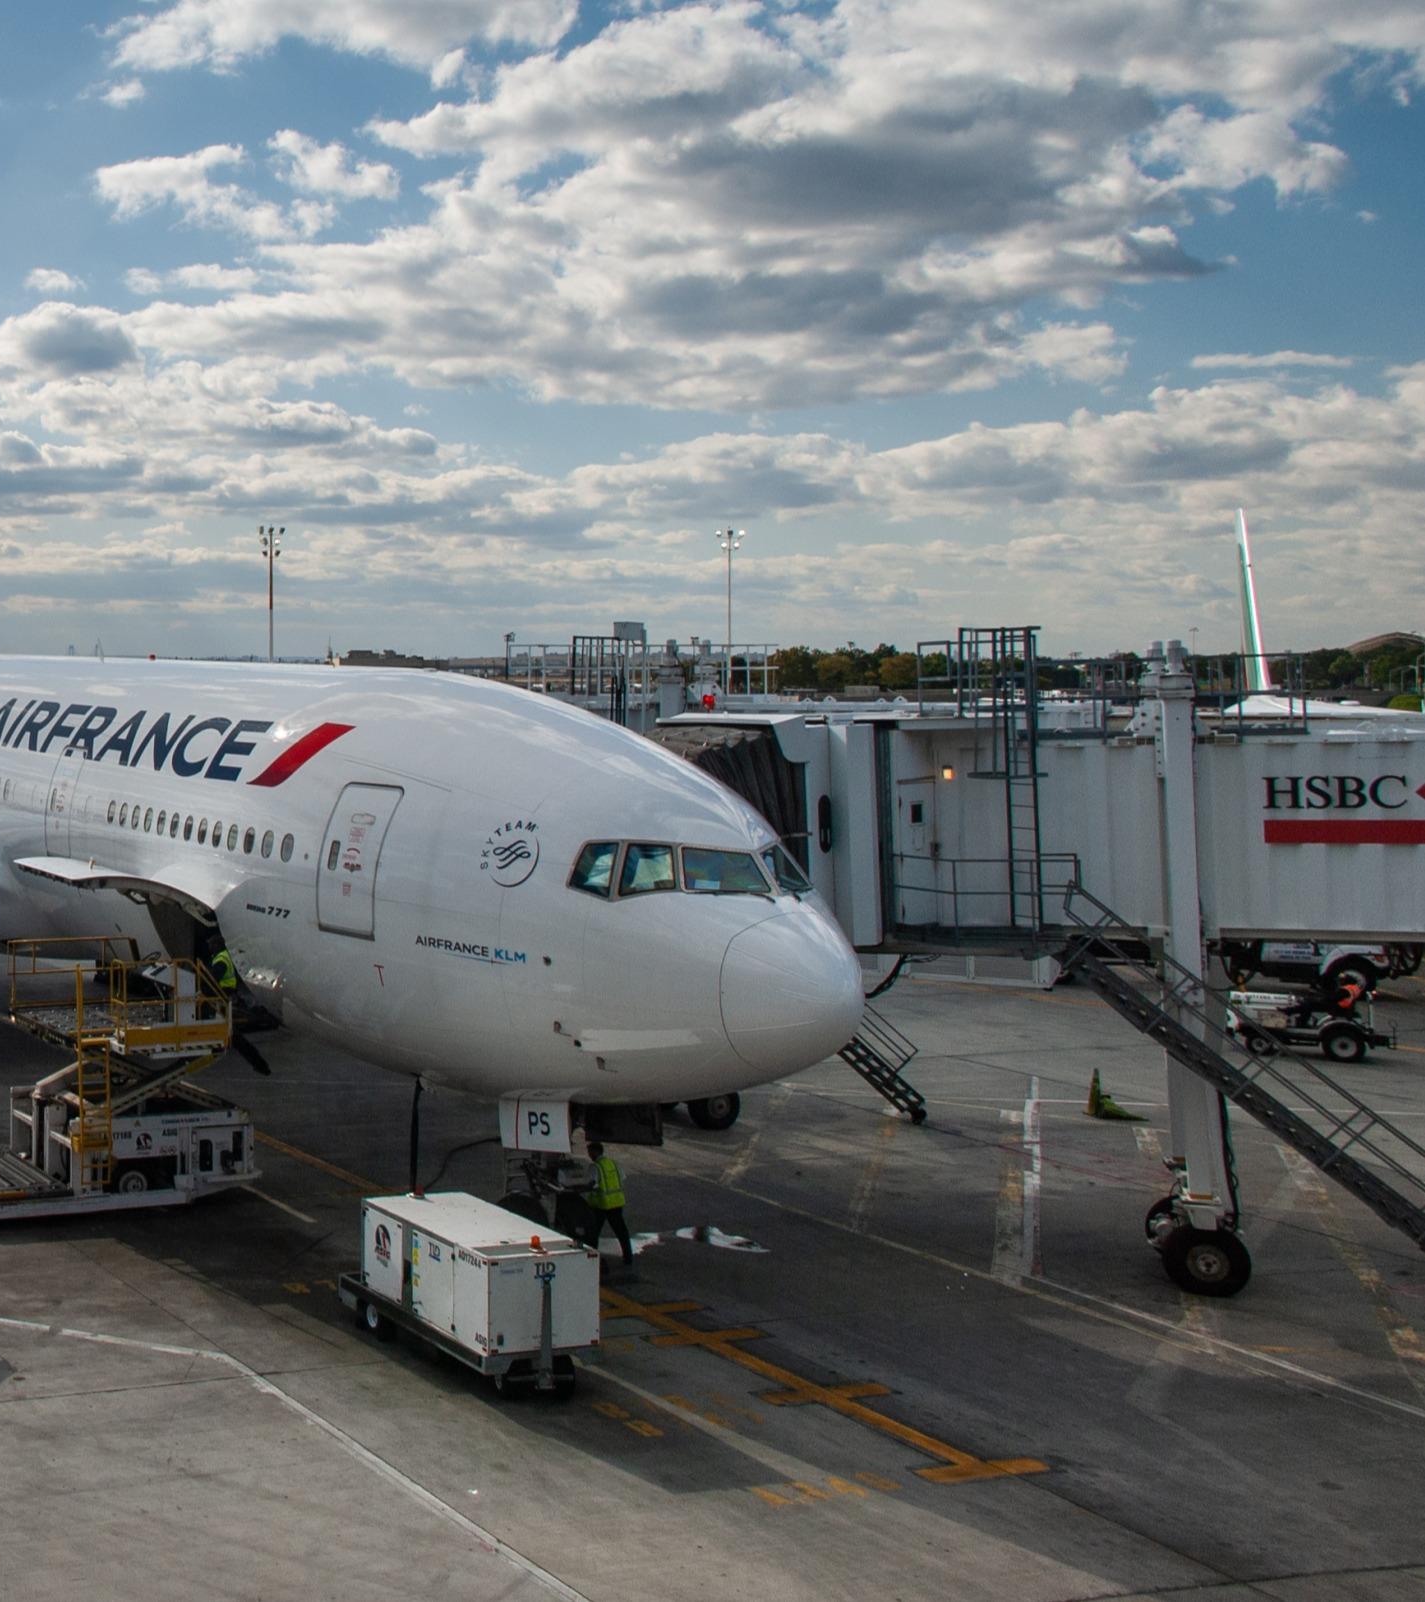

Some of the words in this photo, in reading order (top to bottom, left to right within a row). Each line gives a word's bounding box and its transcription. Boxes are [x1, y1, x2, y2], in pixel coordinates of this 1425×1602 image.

[1262, 775, 1409, 809] HSBC
[479, 820, 538, 870] SKYTEAM
[267, 905, 291, 919] 777
[415, 935, 489, 957] AIRFRANCE
[494, 947, 526, 963] KLM
[527, 1110, 550, 1136] PS
